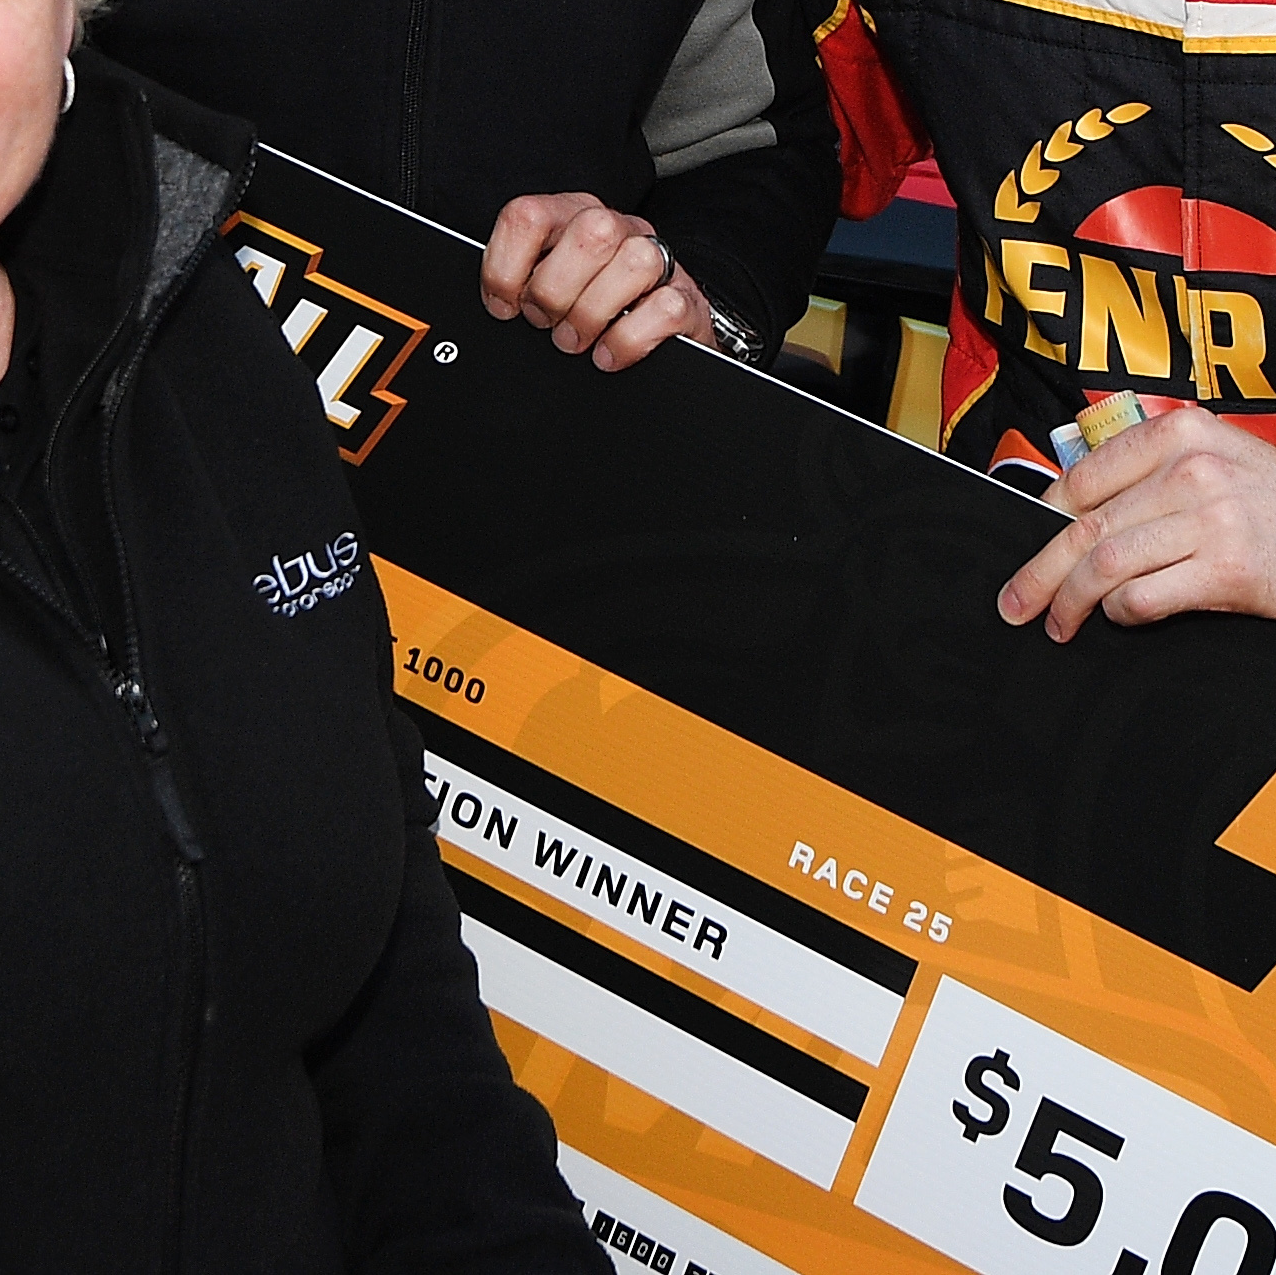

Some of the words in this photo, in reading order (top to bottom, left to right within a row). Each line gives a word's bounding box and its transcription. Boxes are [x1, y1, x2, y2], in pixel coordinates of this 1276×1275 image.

[403, 647, 487, 706] 1000
[533, 828, 729, 961] WINNER
[788, 841, 894, 913] RACE
[902, 900, 954, 943] 25
